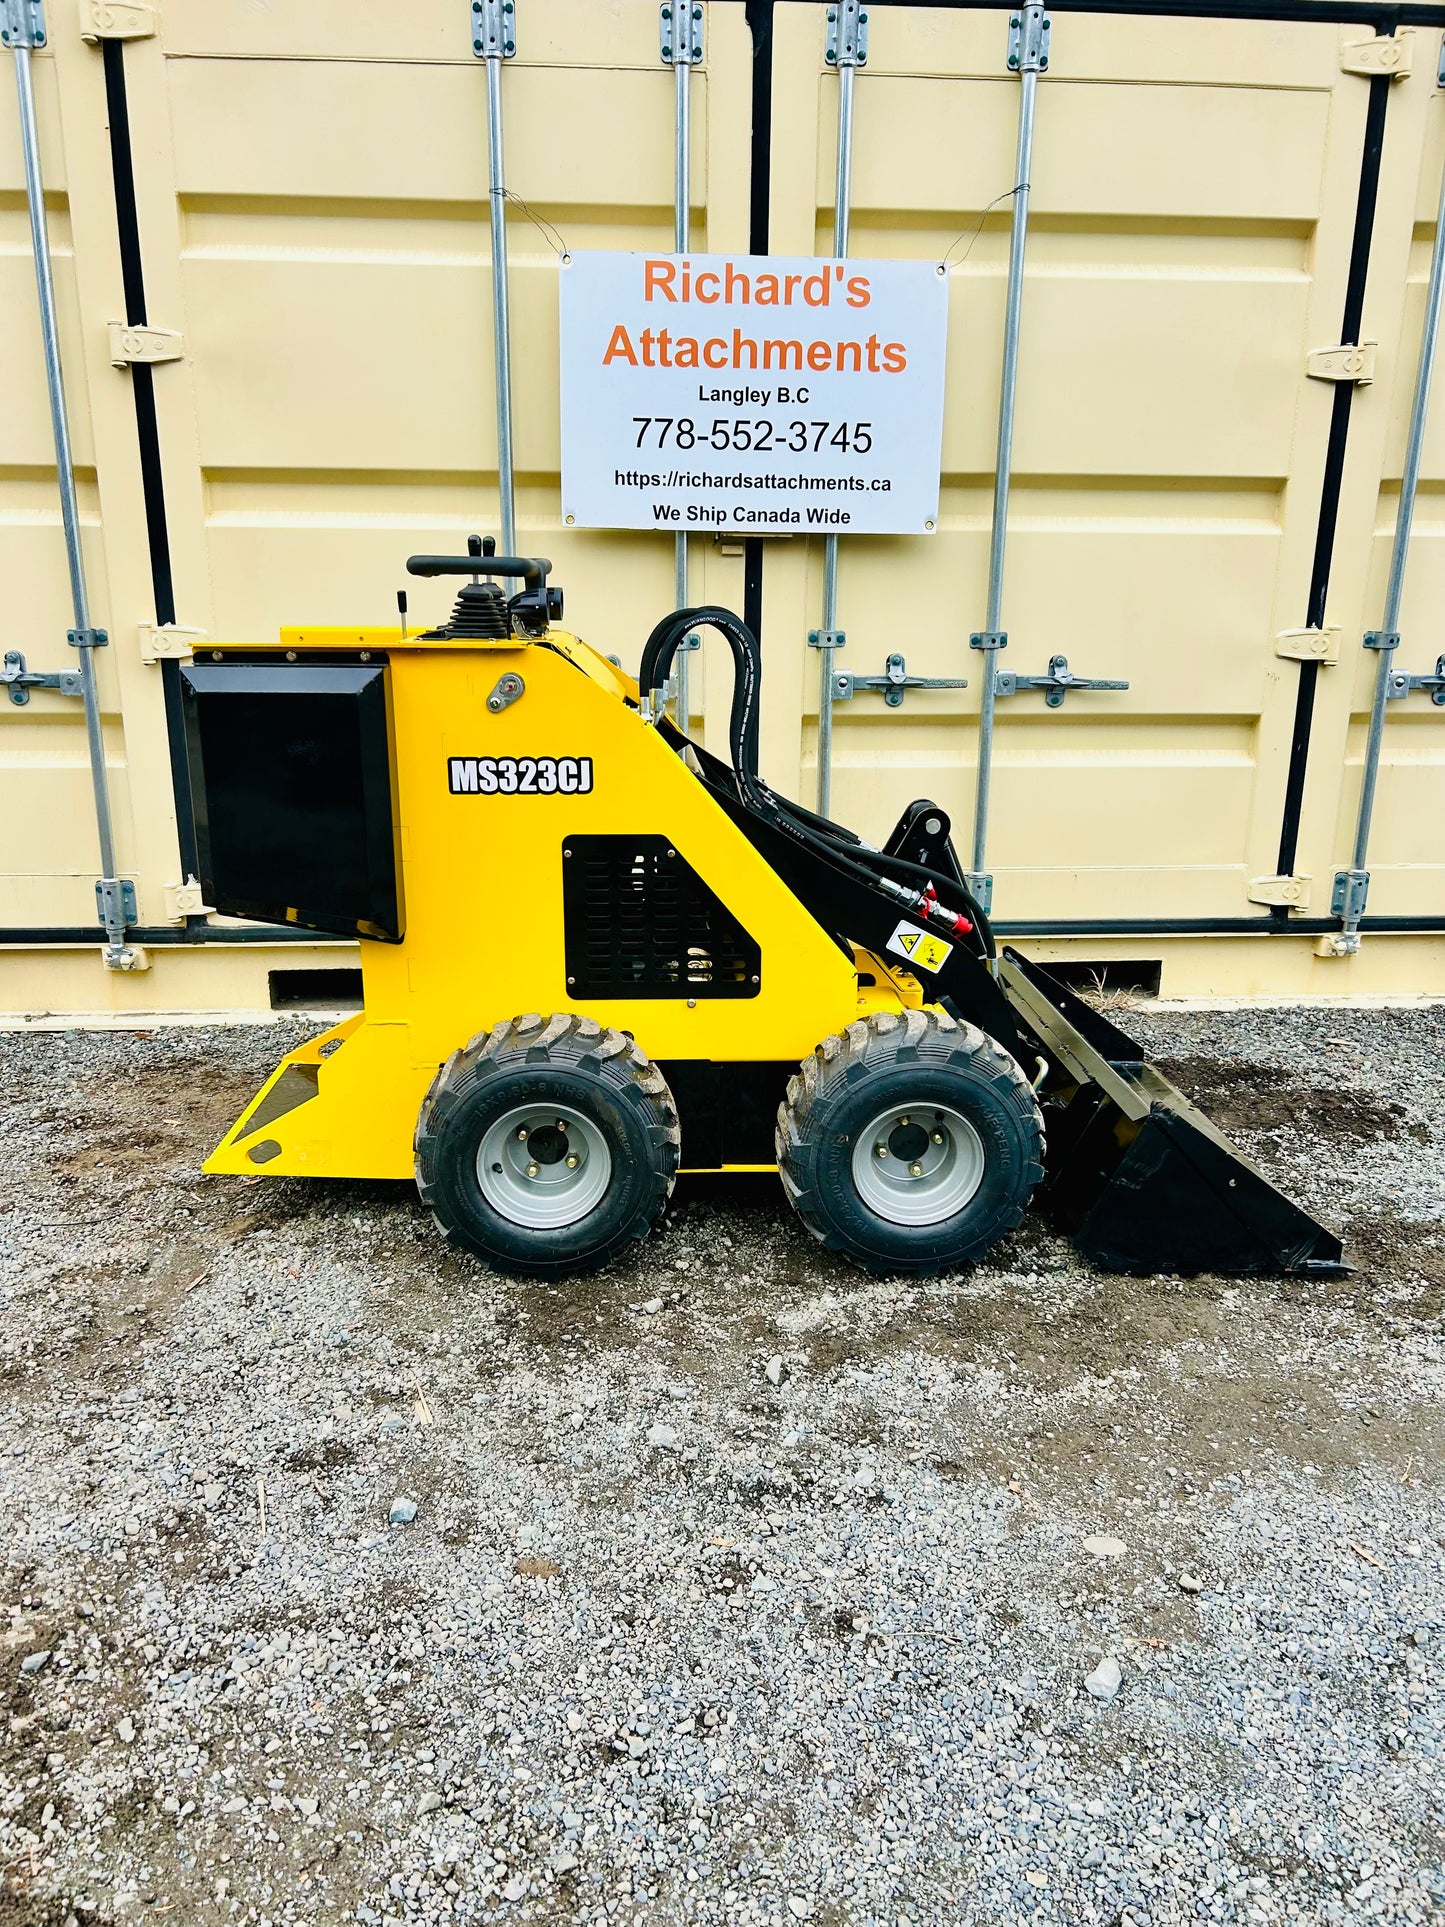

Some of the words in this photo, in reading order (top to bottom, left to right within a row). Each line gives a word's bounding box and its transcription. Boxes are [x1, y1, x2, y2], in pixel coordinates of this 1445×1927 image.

[644, 260, 871, 308] Richard's
[602, 325, 907, 373] Attachments
[699, 385, 771, 407] Langley
[778, 387, 809, 403] B.C
[633, 418, 872, 453] 778-552-3745
[615, 470, 890, 491] https://richardsattachments.ca
[653, 505, 680, 520] We
[687, 506, 727, 525] Ship
[733, 507, 800, 523] Canada
[807, 508, 850, 524] Wide
[450, 758, 592, 793] MS323CJ
